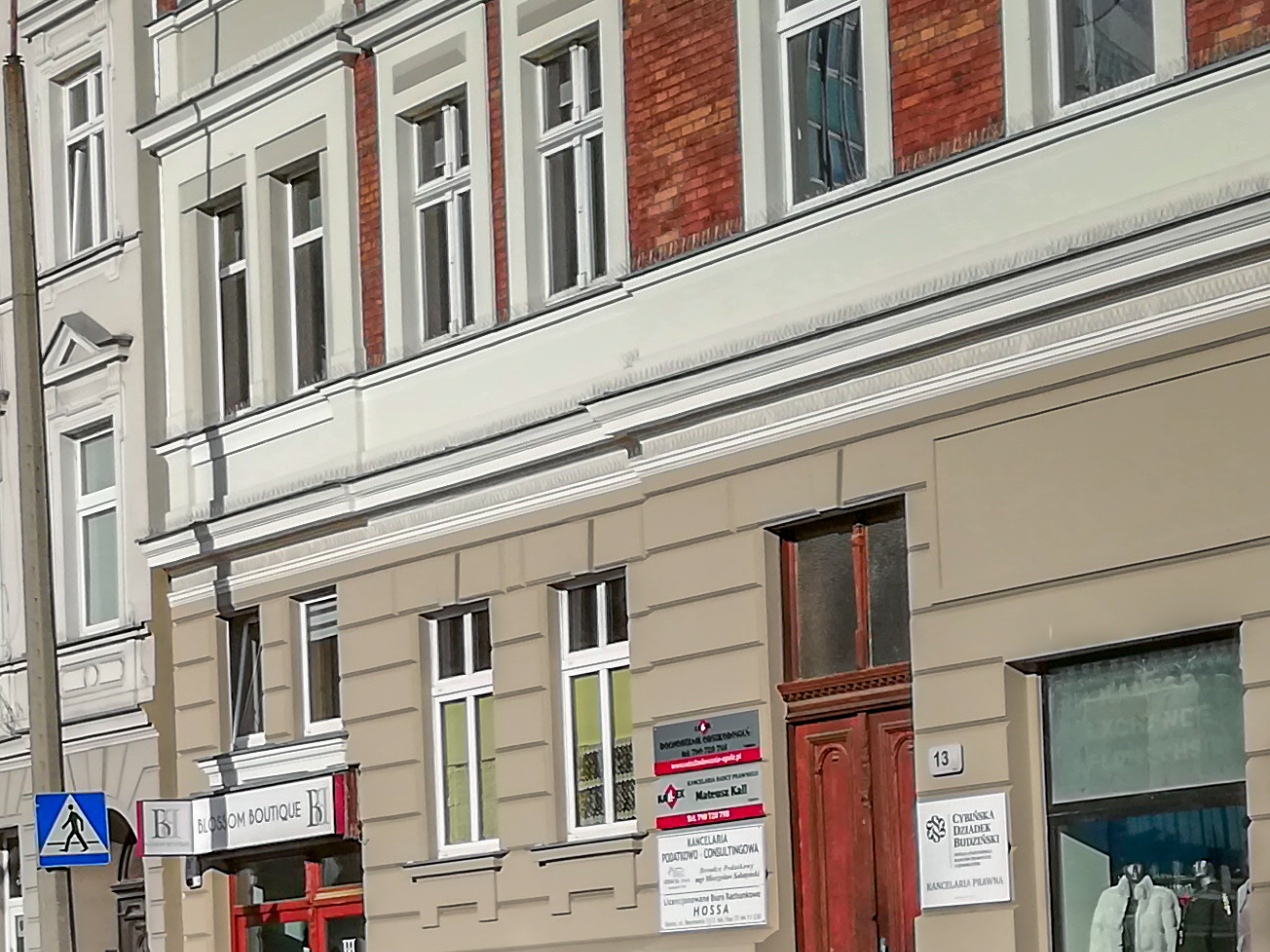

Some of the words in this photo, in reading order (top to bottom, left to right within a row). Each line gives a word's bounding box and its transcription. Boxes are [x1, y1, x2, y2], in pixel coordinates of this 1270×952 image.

[933, 750, 949, 767] 13
[695, 789, 729, 801] Mateusz
[731, 784, 748, 797] Kall
[197, 810, 246, 834] BLOSSOM
[248, 801, 301, 825] BOUTIQUE
[952, 810, 995, 824] CYBIŃSKA
[953, 823, 992, 836] DZIADEK
[687, 834, 728, 847] KANCELARIA
[954, 834, 1000, 848] BUDZIŃSKI
[661, 850, 699, 863] PODATKOWO
[704, 843, 759, 859] CONSULTINGOWA
[926, 878, 971, 891] KANCELARIA
[972, 876, 1004, 888] PRAWNA
[693, 904, 729, 917] HOSSA
